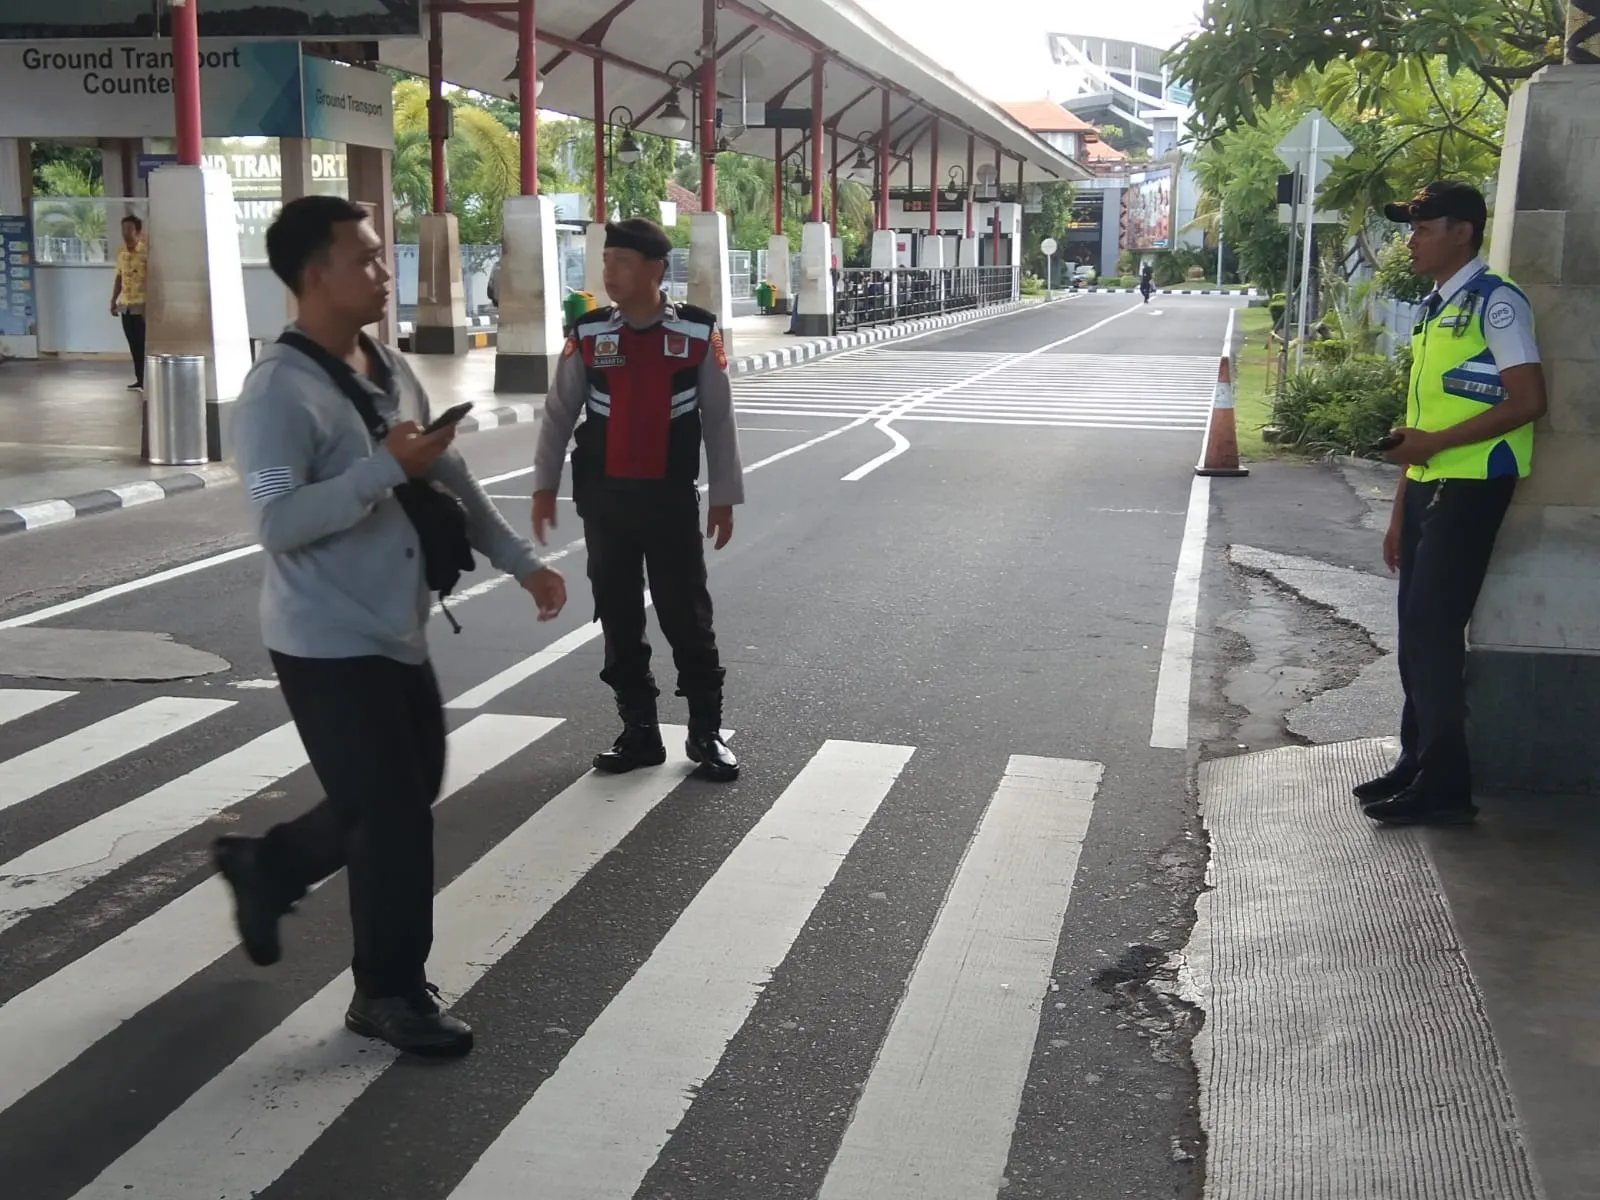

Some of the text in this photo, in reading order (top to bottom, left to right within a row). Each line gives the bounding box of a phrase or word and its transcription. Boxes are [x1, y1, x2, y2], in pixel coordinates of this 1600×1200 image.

[22, 47, 241, 70] Ground Tranort
[315, 88, 383, 118] Ground Transport
